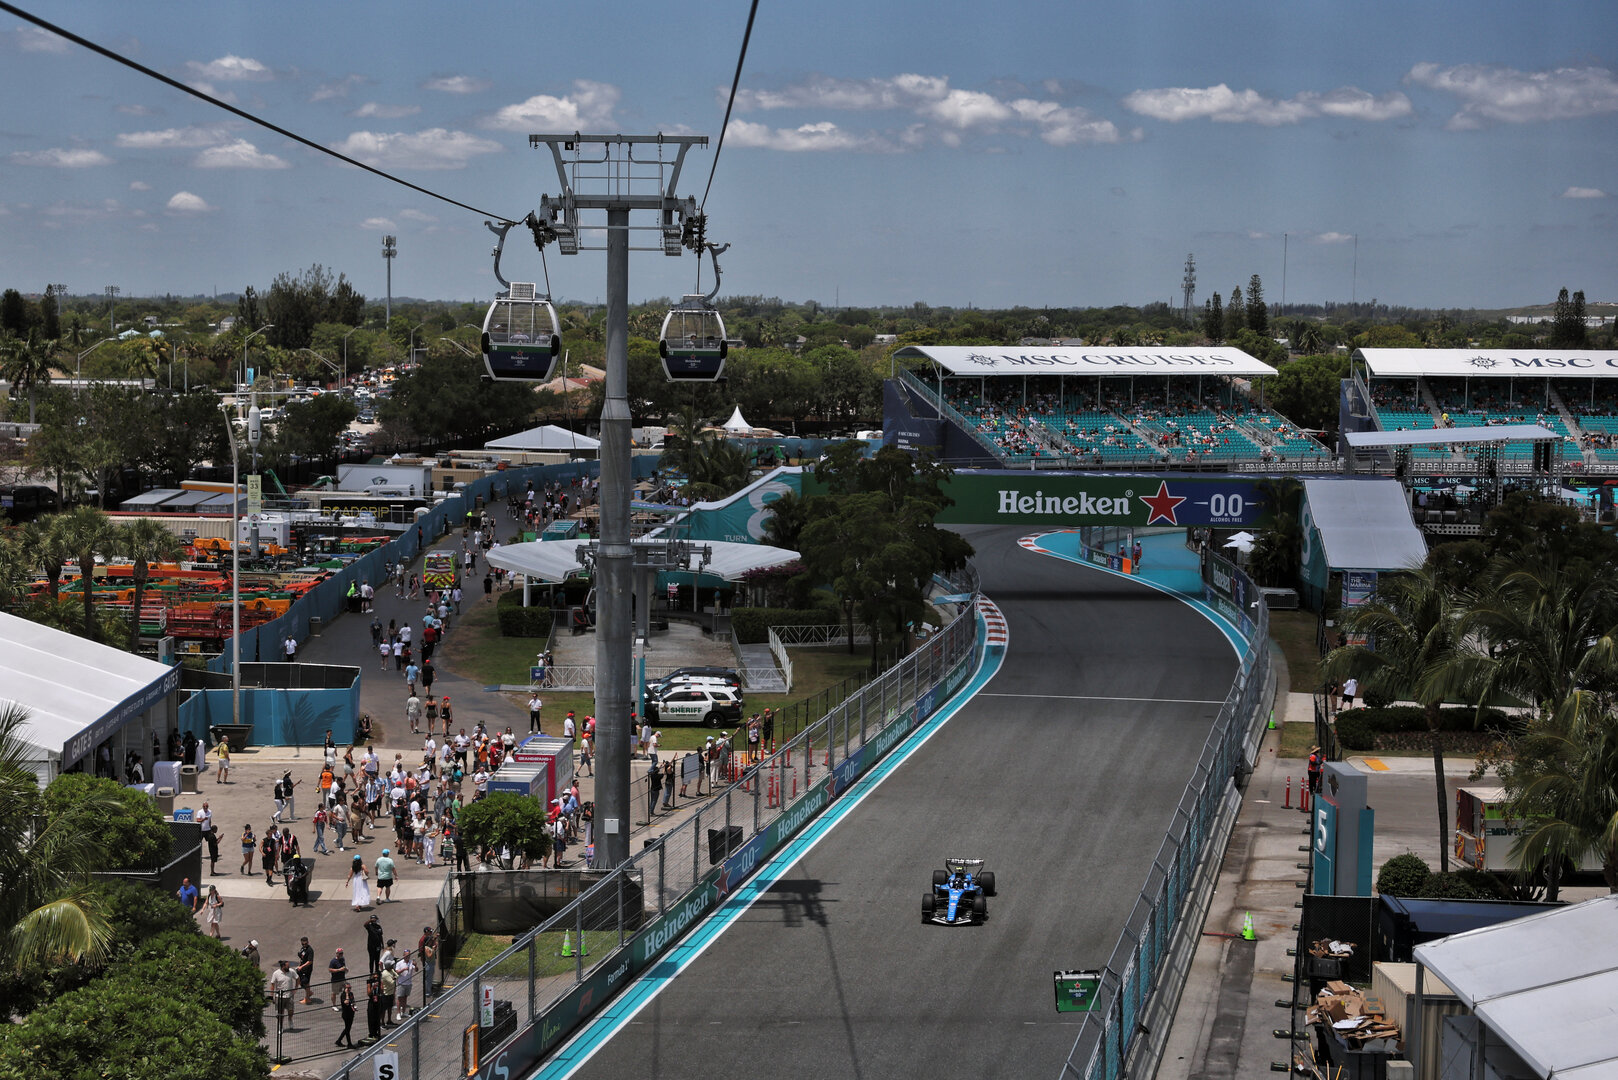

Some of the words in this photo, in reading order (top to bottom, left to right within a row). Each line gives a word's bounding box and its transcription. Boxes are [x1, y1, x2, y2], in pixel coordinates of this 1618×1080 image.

[1001, 354, 1077, 365] MSC
[1081, 354, 1234, 365] CRUISES
[1508, 357, 1595, 368] MSC
[1211, 493, 1243, 517] 0.0
[875, 719, 908, 756] Heineken
[777, 793, 822, 842] Heineken
[1317, 808, 1327, 852] 5
[643, 889, 710, 961] Heineken
[608, 964, 625, 987] Formula
[379, 1064, 395, 1080] S
